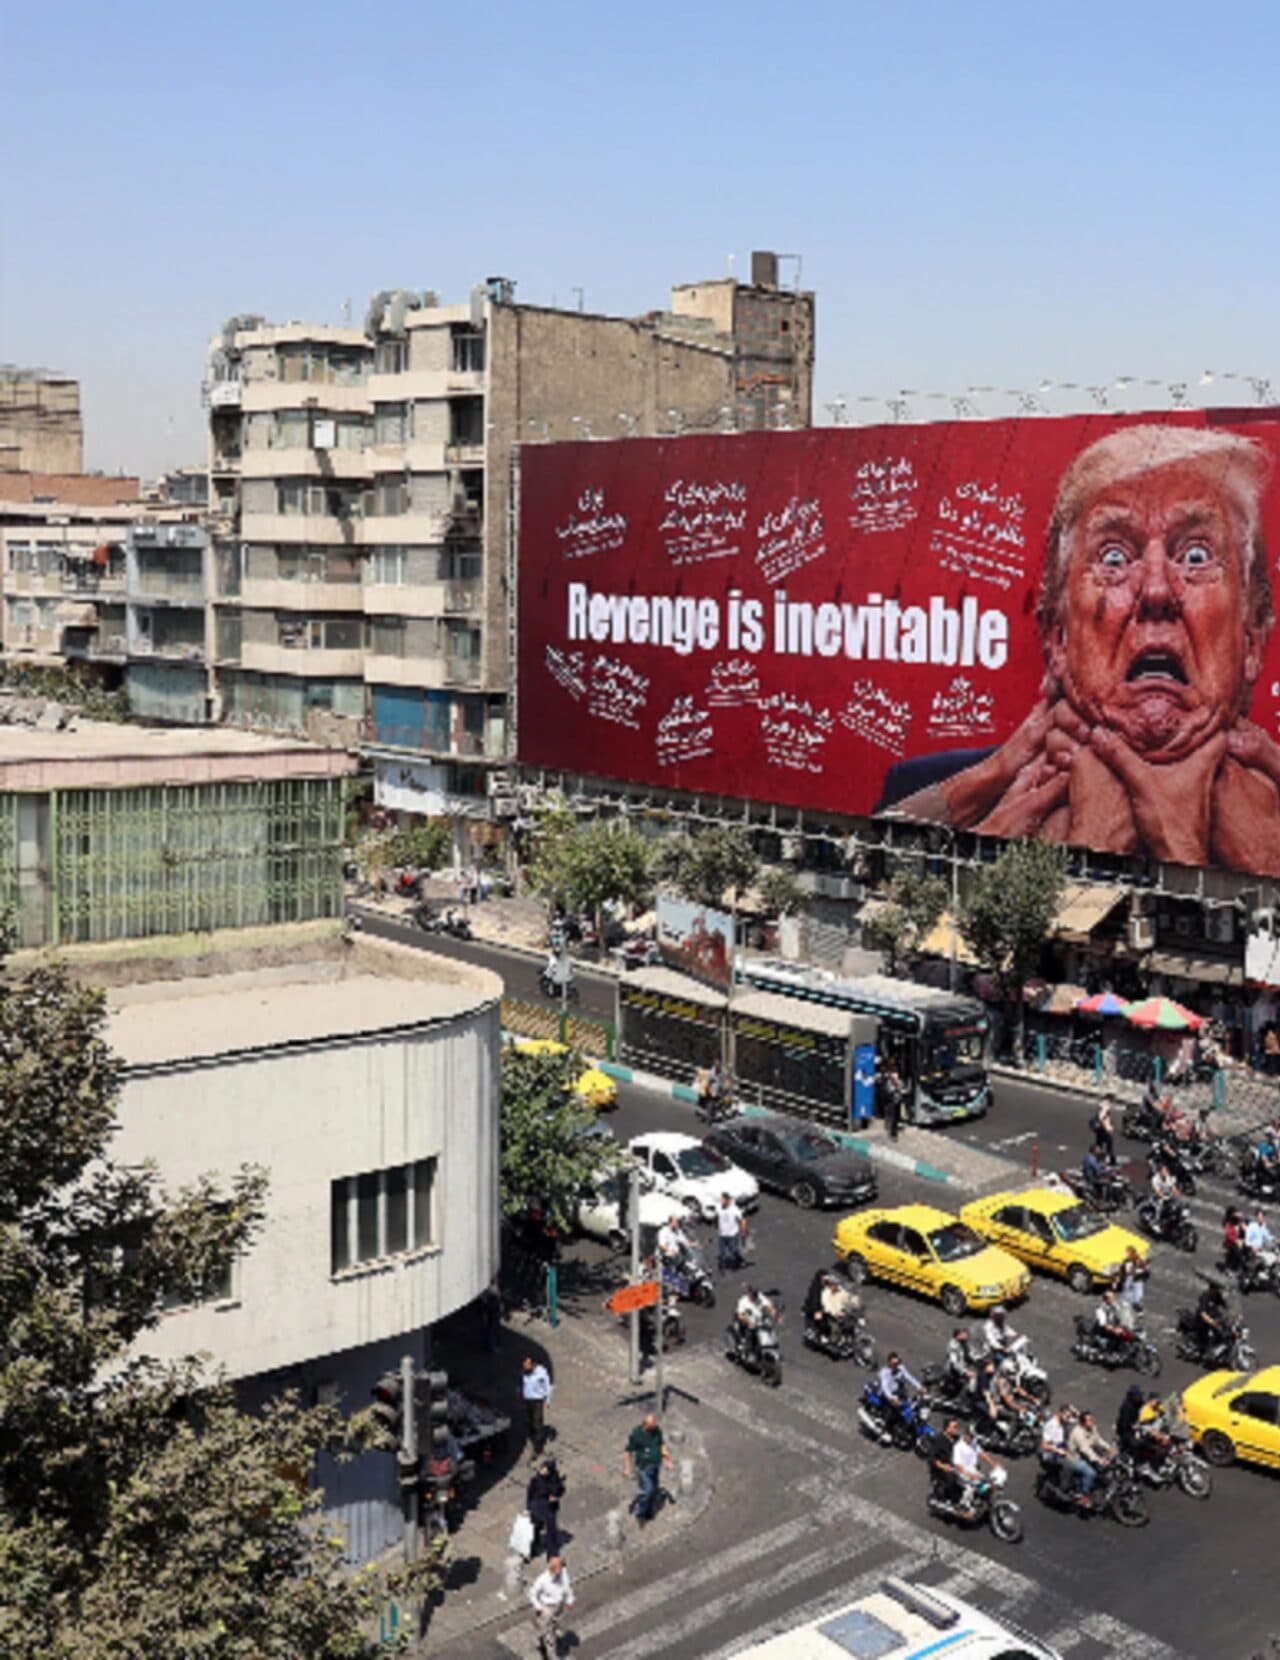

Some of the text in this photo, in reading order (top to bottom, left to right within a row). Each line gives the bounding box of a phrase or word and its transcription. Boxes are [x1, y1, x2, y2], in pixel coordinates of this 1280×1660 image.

[568, 584, 1006, 668] Revenge is inevitable
